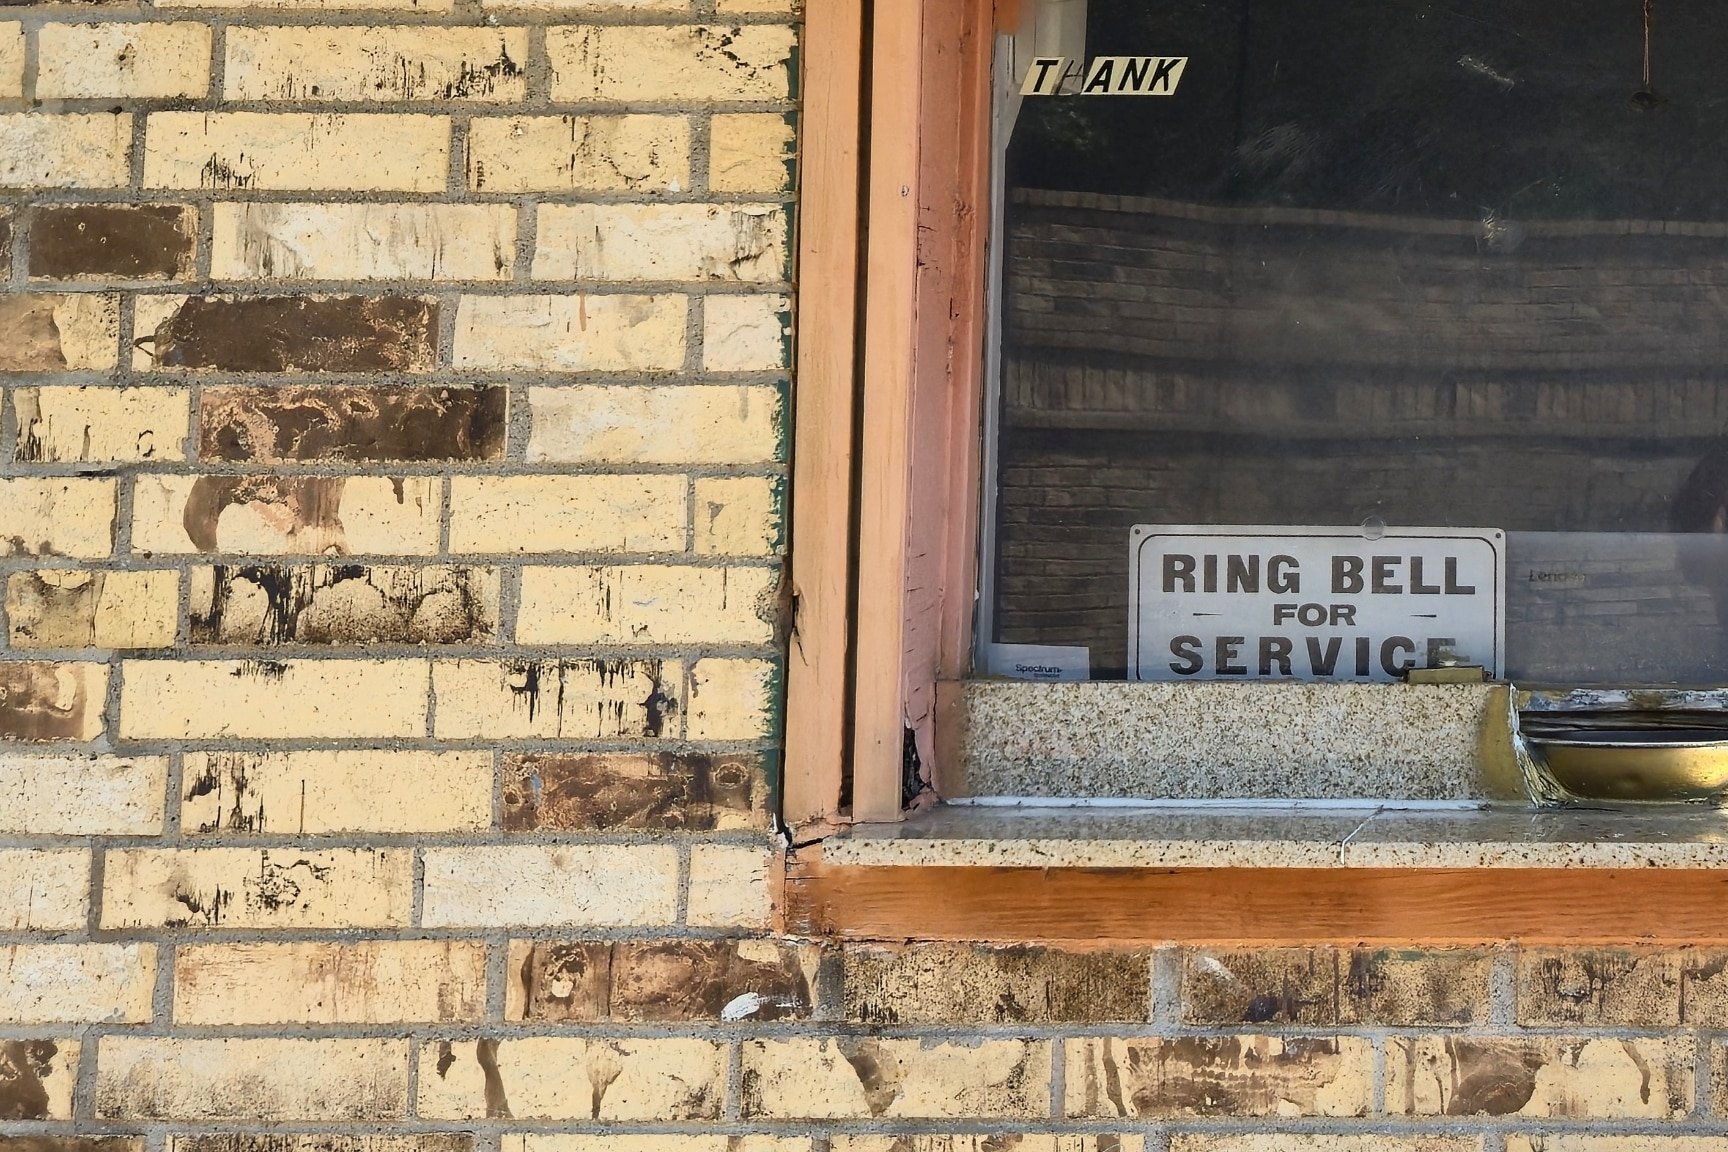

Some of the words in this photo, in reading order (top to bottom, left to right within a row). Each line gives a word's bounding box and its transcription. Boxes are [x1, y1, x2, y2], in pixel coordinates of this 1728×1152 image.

[1162, 553, 1300, 594] RING
[1331, 555, 1476, 595] BELL
[1273, 603, 1357, 627] FOR
[1015, 663, 1061, 674] Spectrum
